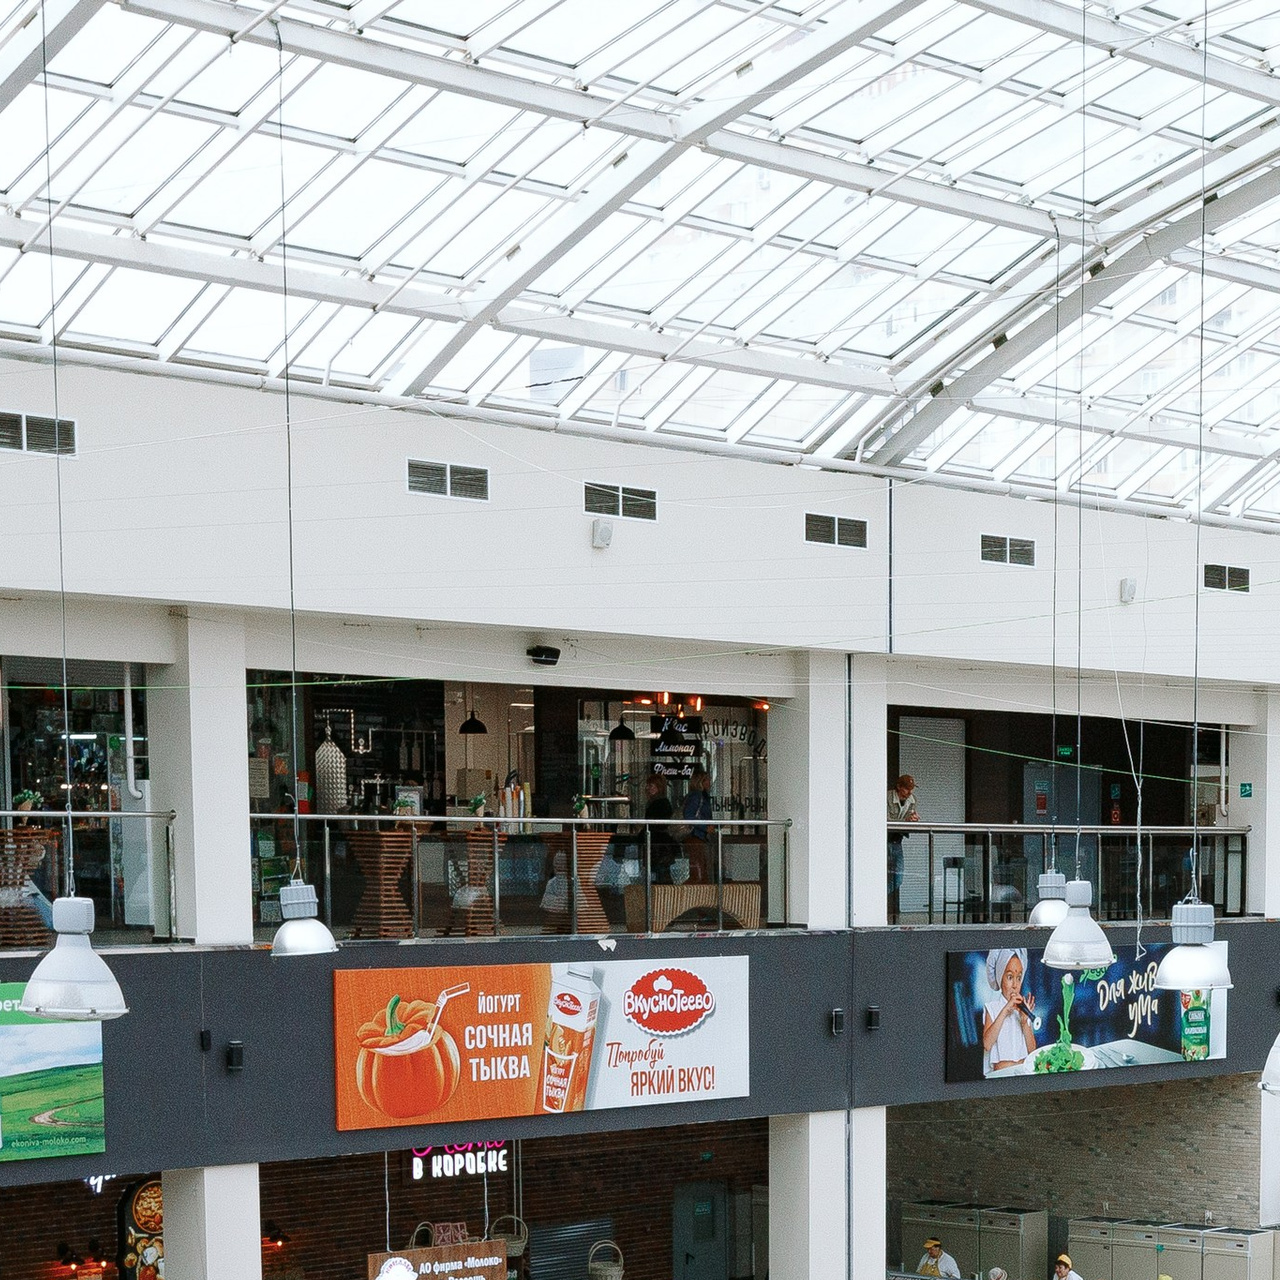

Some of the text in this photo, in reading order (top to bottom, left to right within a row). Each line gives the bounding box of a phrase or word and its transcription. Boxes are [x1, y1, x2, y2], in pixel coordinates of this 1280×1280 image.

[477, 991, 521, 1015] ЙОГУРТ
[1096, 978, 1125, 1011] Для
[464, 1022, 533, 1050] СОЧНАЯ
[606, 1038, 666, 1070] Попробуй
[469, 1057, 531, 1083] ТЫКВА
[629, 1066, 715, 1096] ЯРКИЙ ВКУС!
[11, 1136, 87, 1148] ekoniva-moloko.com
[412, 1149, 508, 1180] В КОРОБКЕ
[419, 1262, 430, 1275] АО
[432, 1260, 463, 1275] фирма
